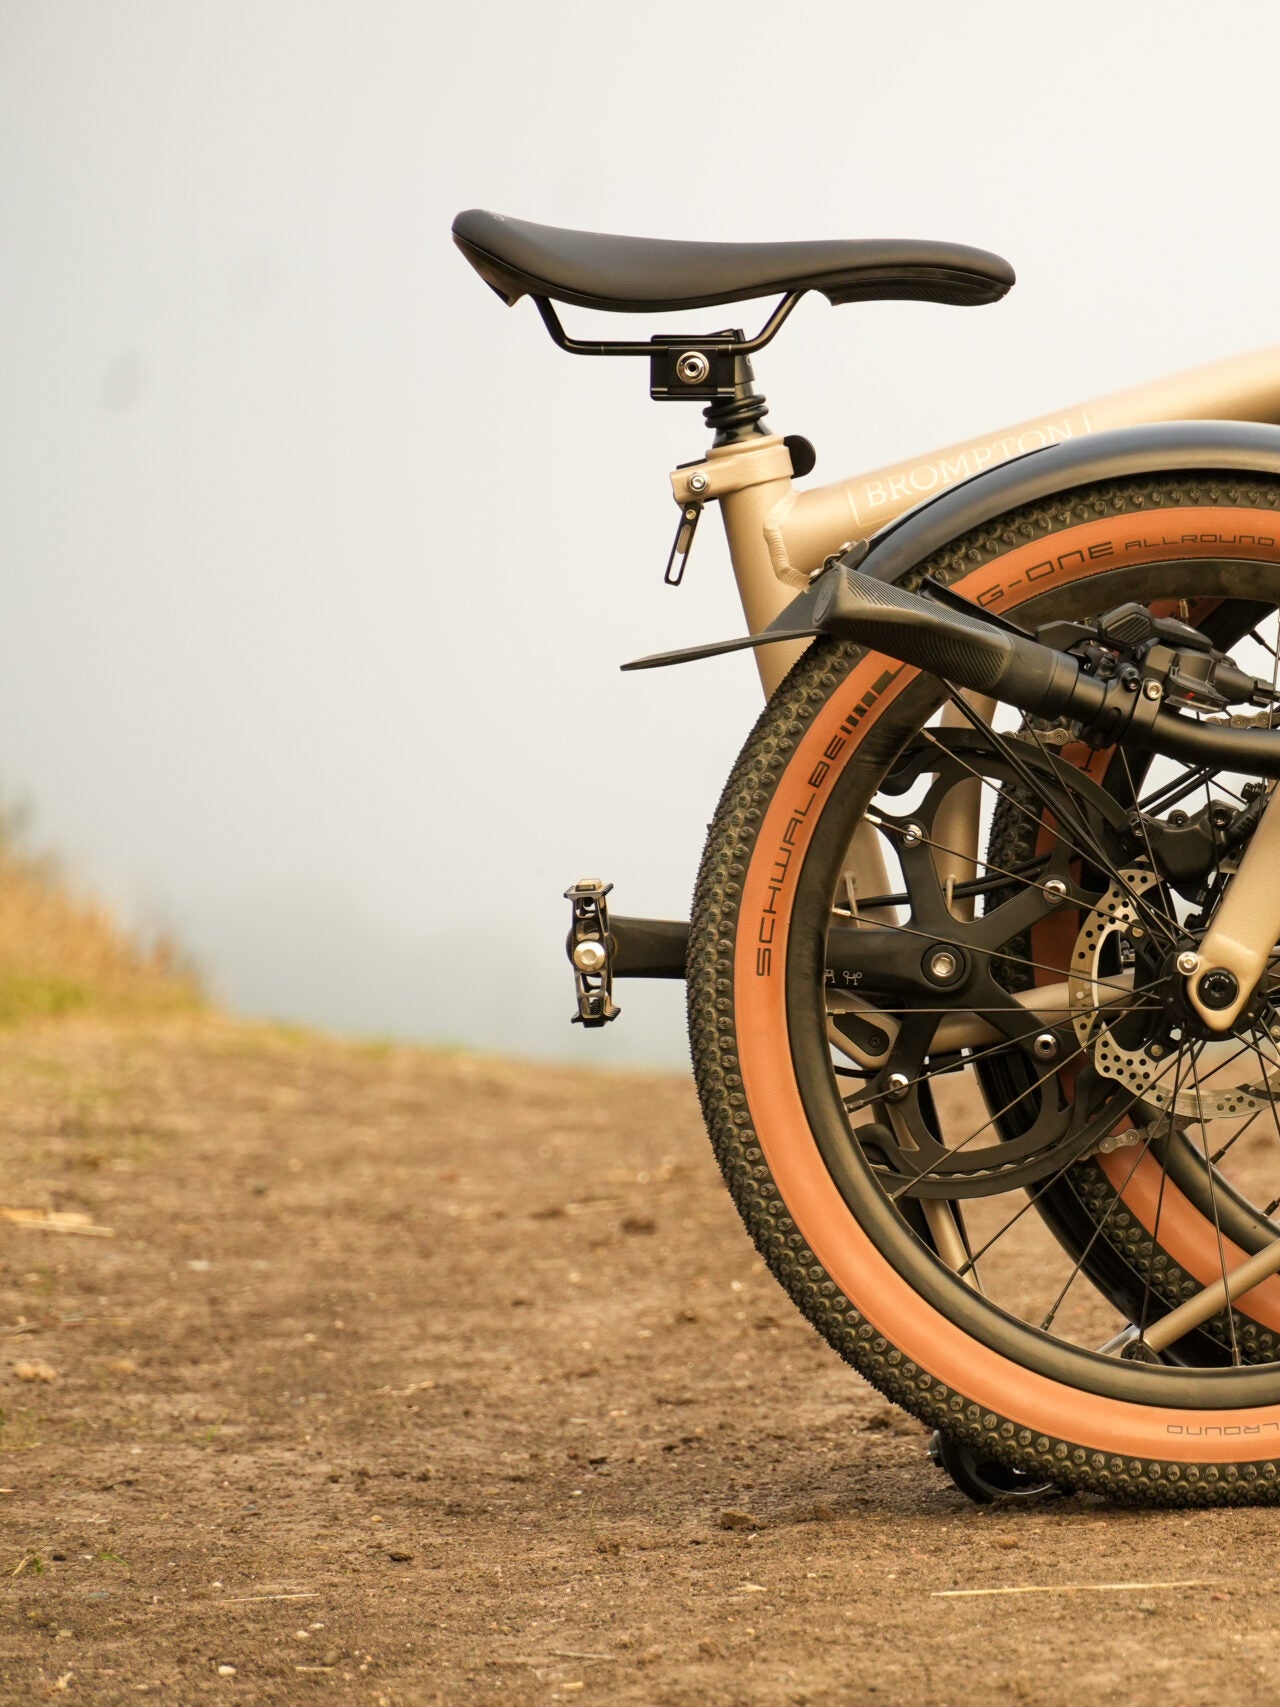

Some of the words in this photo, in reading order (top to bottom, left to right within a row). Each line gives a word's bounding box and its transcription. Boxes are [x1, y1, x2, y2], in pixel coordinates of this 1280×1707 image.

[866, 418, 1073, 508] BROMPTON
[975, 541, 1115, 607] G-ONE
[1124, 533, 1276, 552] ALLROUND
[756, 733, 847, 978] SCHWALBE
